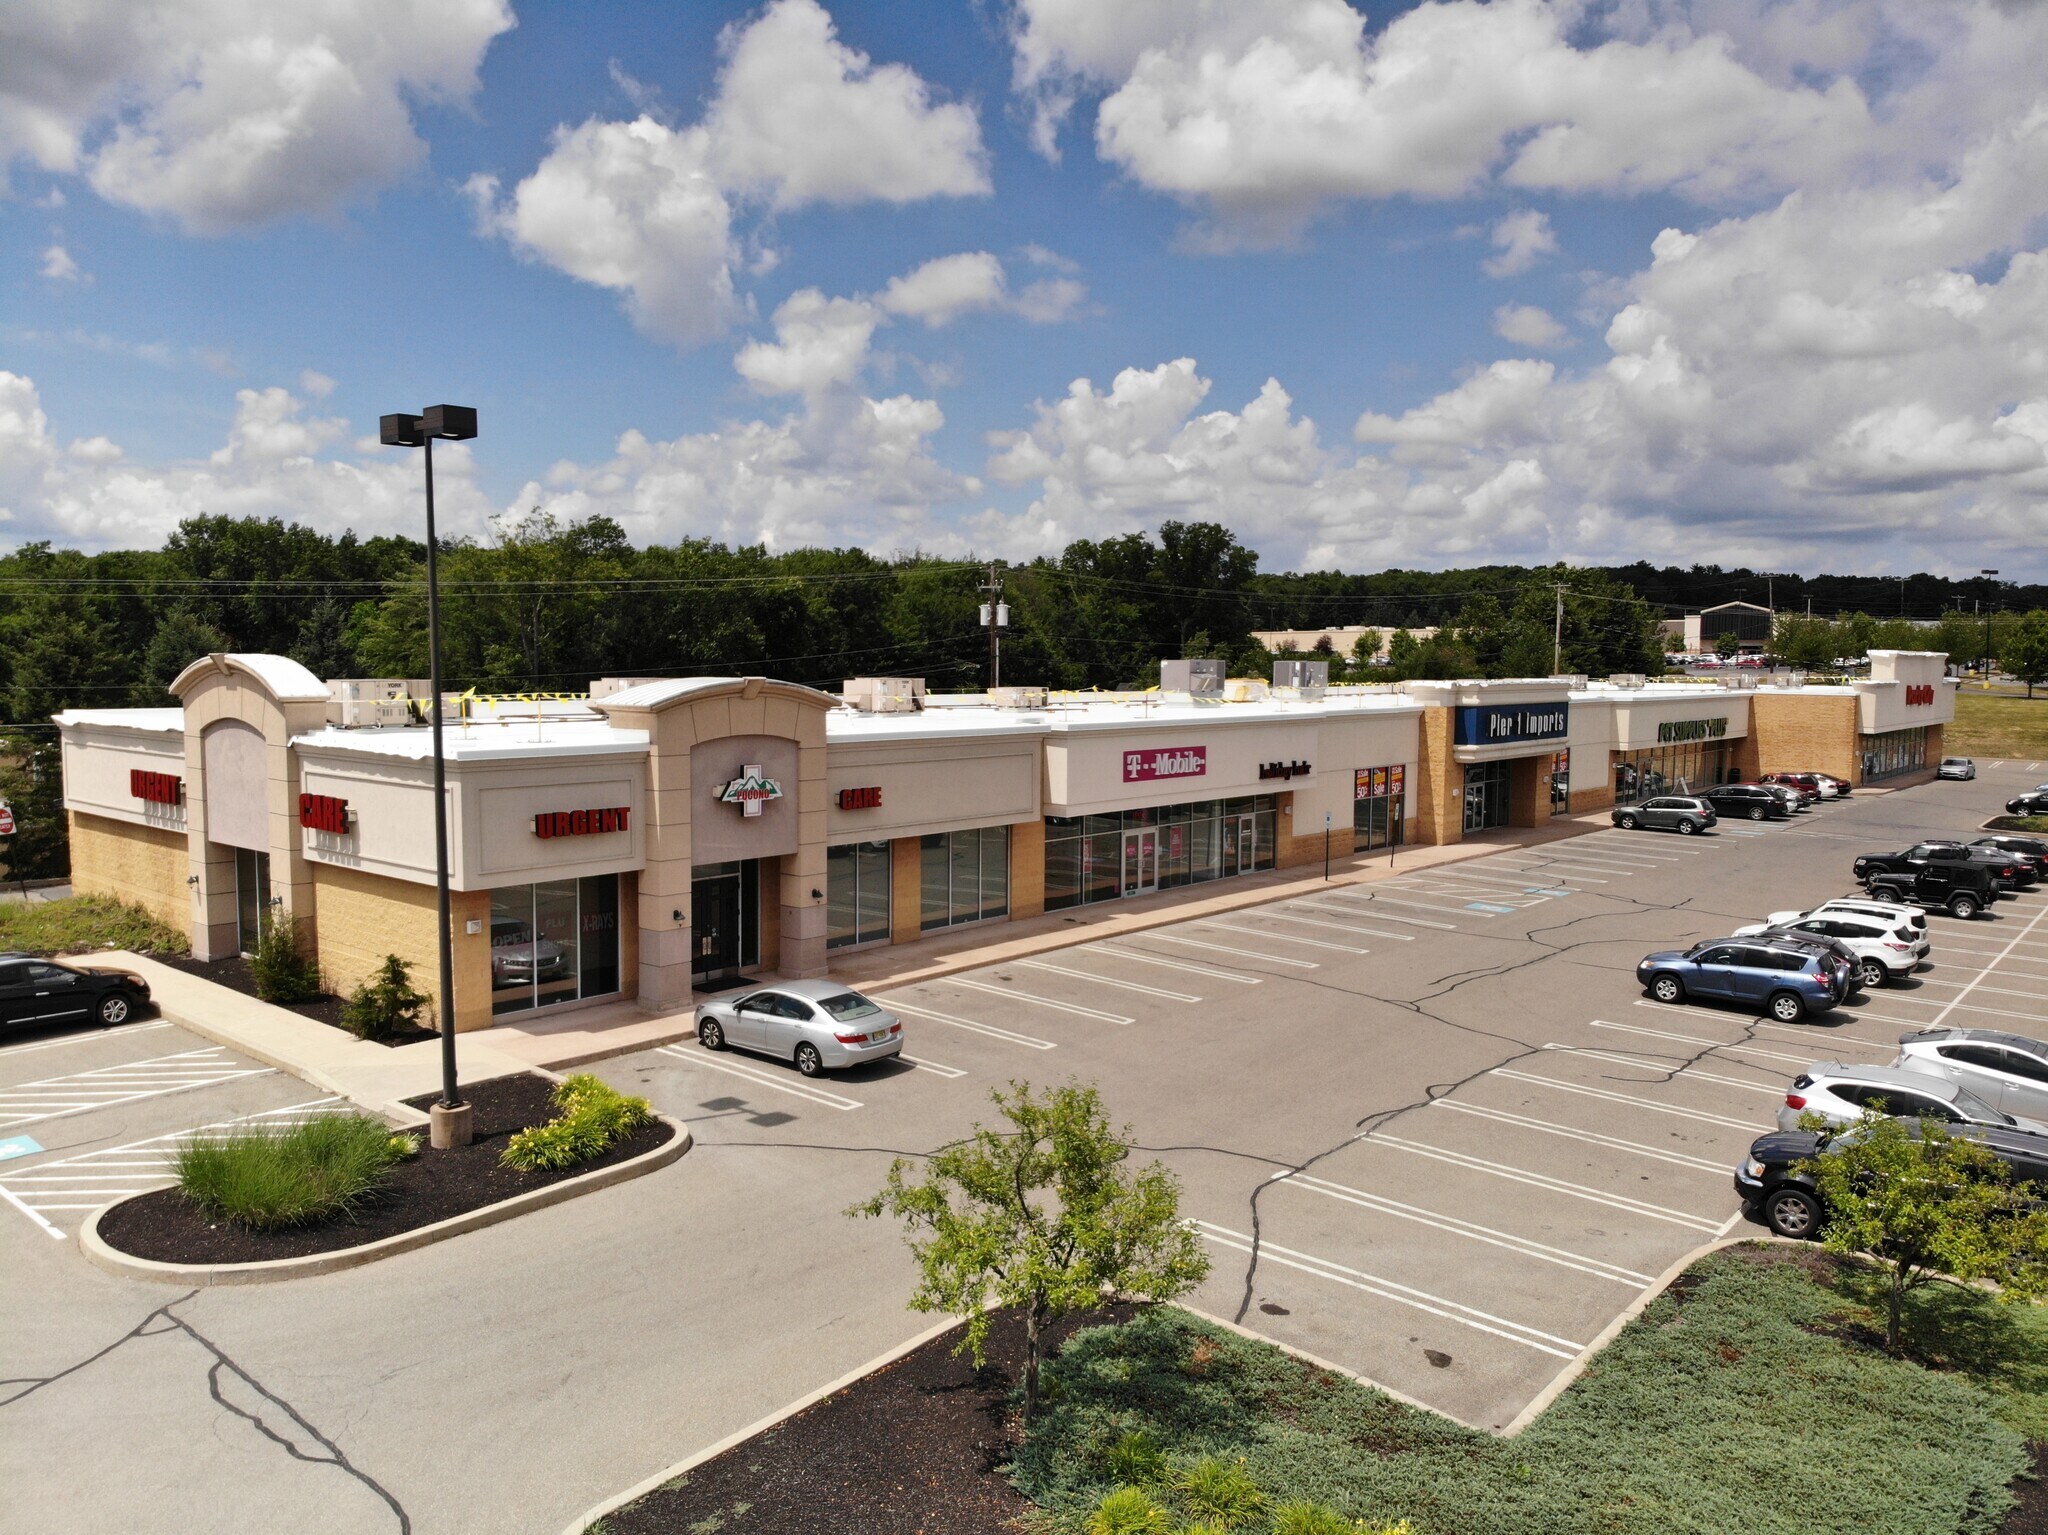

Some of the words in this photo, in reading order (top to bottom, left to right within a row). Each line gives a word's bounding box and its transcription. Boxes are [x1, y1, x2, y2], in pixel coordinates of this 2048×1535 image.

[1490, 713, 1513, 737] Pier
[1517, 712, 1522, 735] 1
[1526, 711, 1564, 736] Imports
[130, 769, 182, 805] URGENT
[736, 788, 770, 801] POCONO
[840, 786, 882, 810] CARE
[299, 793, 349, 834] CARE
[535, 806, 631, 839] URGENT
[493, 929, 531, 947] OPEN
